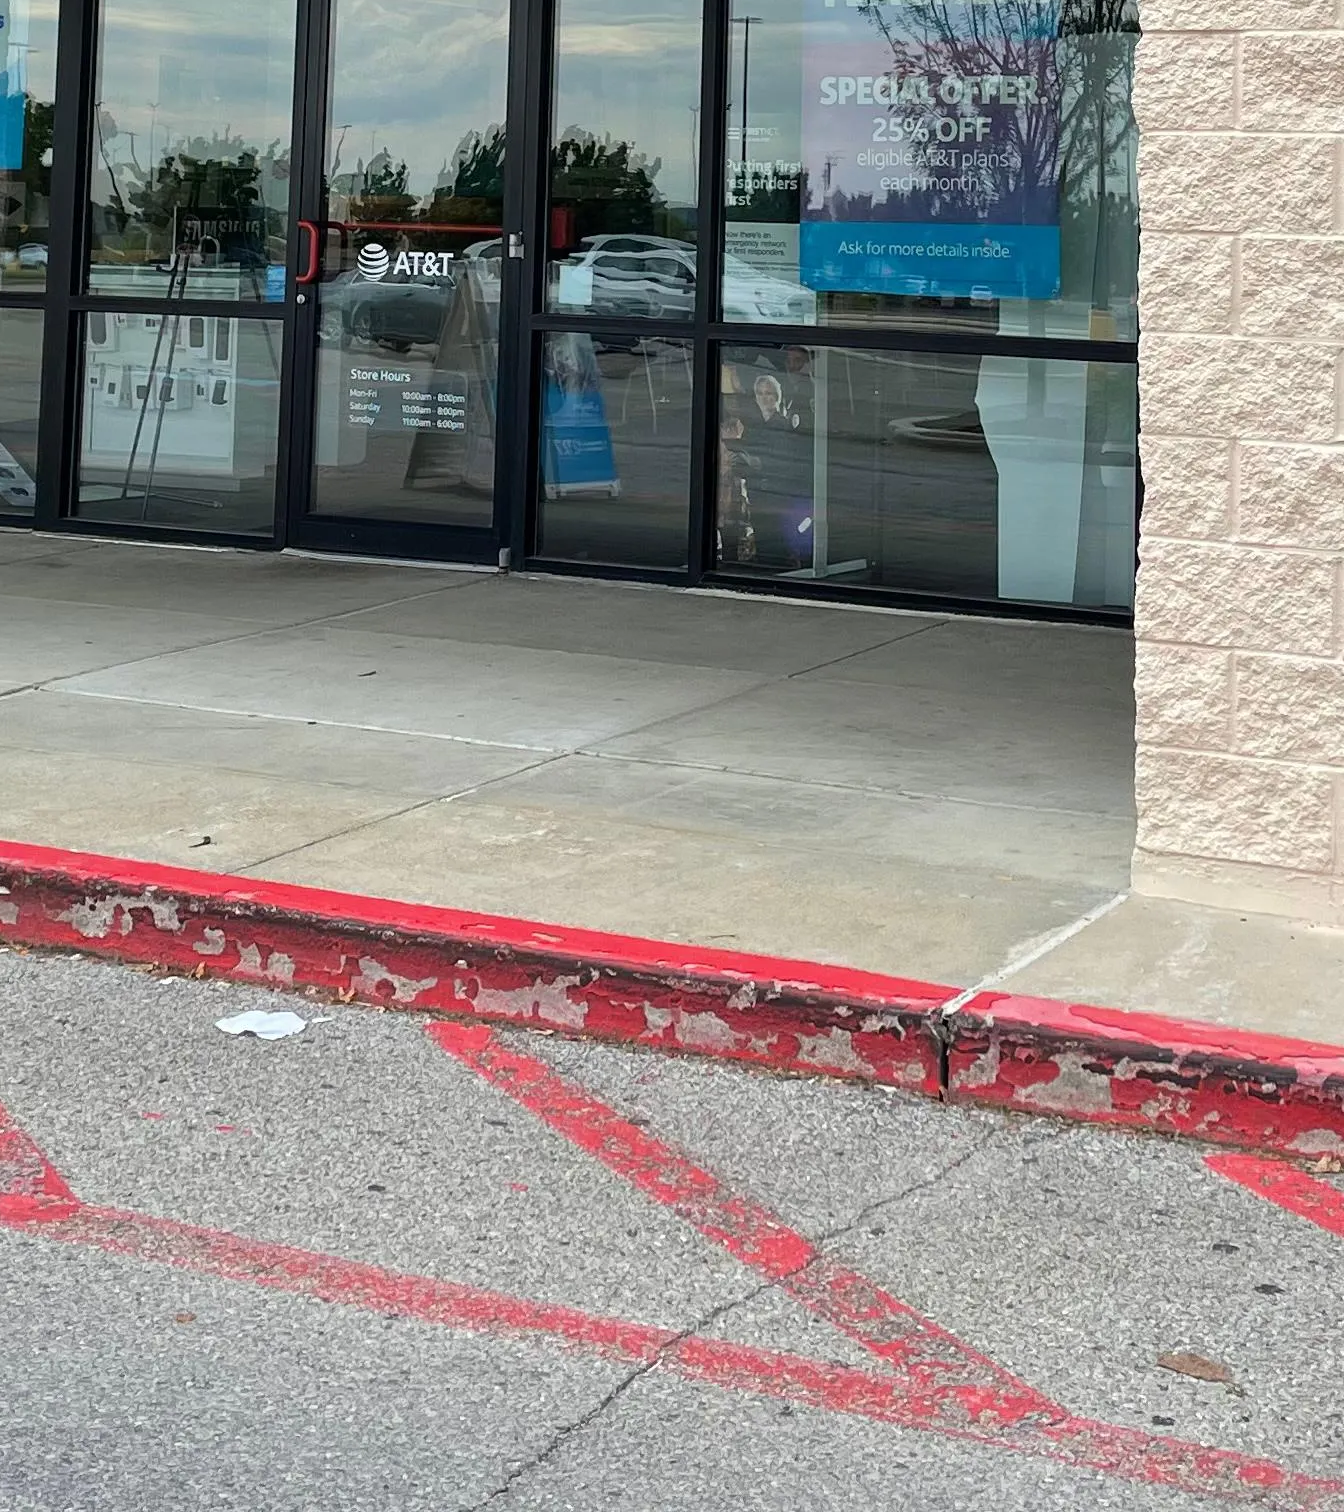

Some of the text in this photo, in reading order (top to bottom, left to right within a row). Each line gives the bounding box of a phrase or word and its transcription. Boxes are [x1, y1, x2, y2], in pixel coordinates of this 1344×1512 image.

[819, 76, 937, 106] SPECIAL
[872, 116, 993, 143] 25% OFF
[857, 149, 1009, 171] eligible AT&T plans
[880, 174, 919, 190] each
[837, 240, 863, 256] Ask
[866, 240, 887, 255] for
[889, 243, 924, 257] more
[926, 242, 969, 258] details
[393, 251, 455, 276] AT&T
[350, 369, 412, 382] Store Hours
[349, 389, 378, 398] Mon-Fri
[401, 392, 432, 401] 10:00am
[349, 402, 382, 413] Saturday
[401, 405, 432, 414] 10:00am
[437, 406, 465, 418] 8:00pm
[349, 414, 376, 426] Sunday
